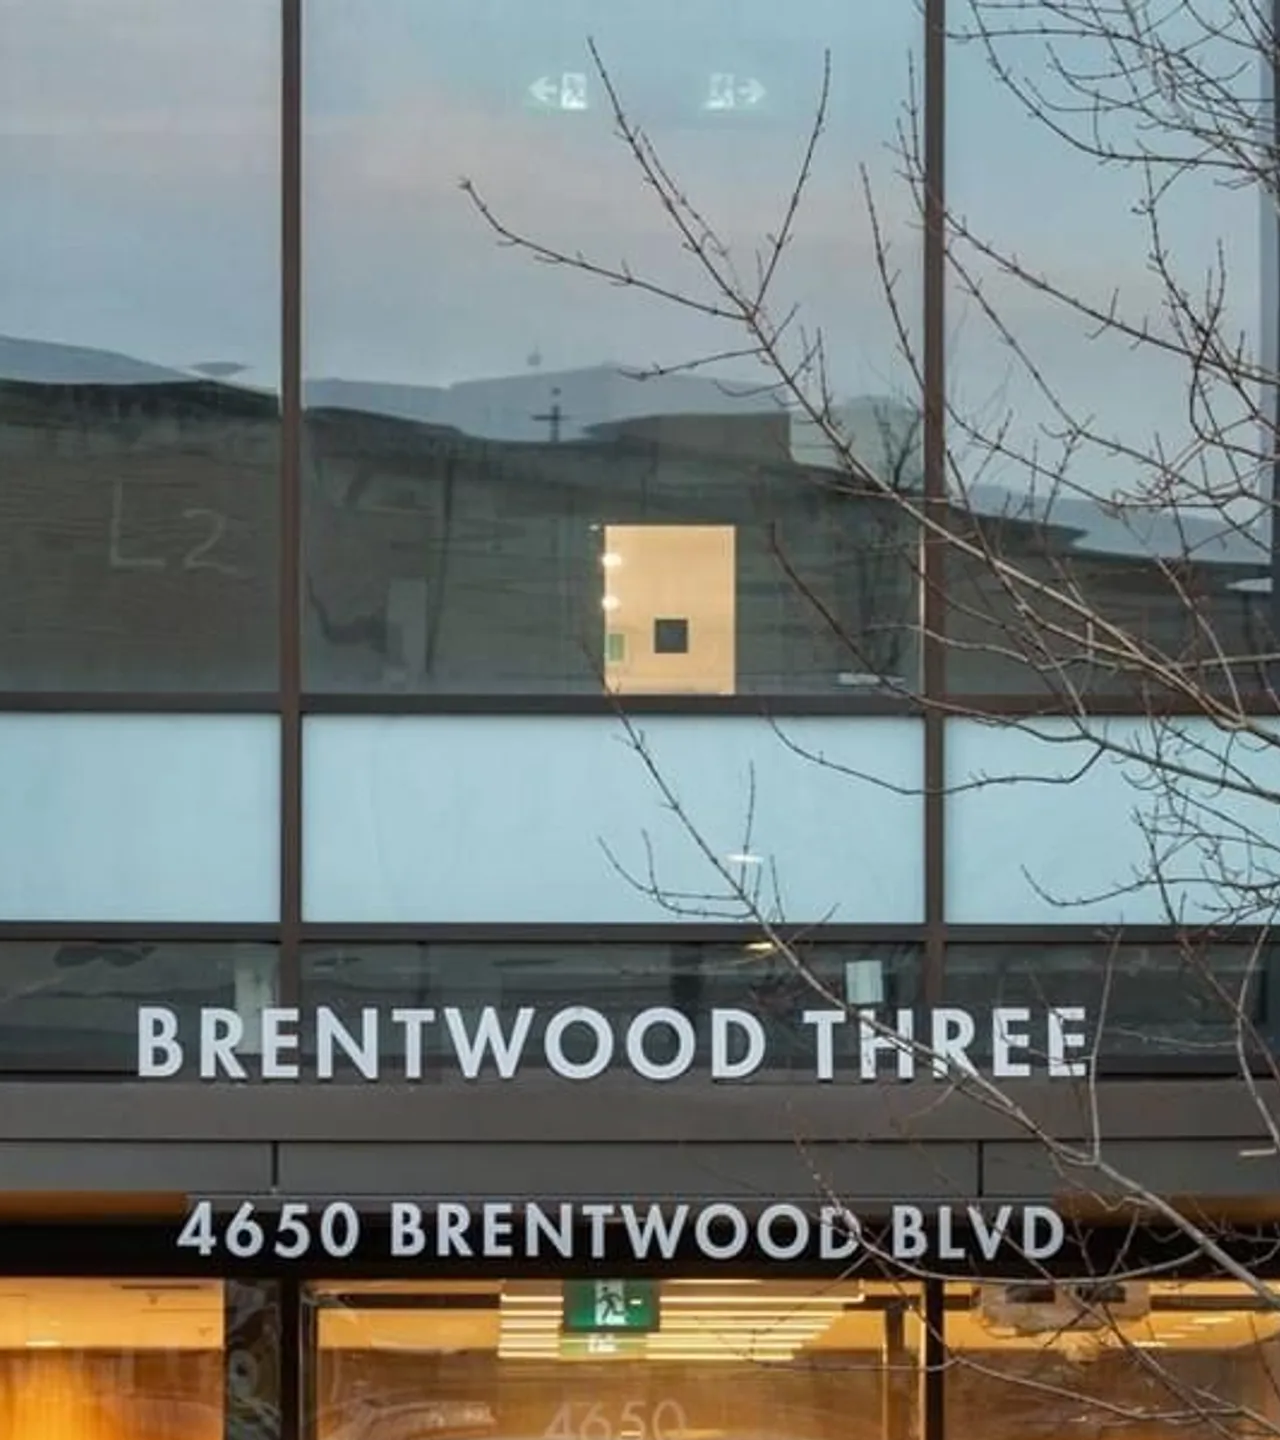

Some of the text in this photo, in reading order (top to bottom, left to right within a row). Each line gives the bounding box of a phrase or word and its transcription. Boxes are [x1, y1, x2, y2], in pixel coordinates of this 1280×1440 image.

[137, 1006, 1088, 1081] BRENTWOOD THREE
[176, 1201, 1065, 1260] 4650 BRENTWOOD BLVD
